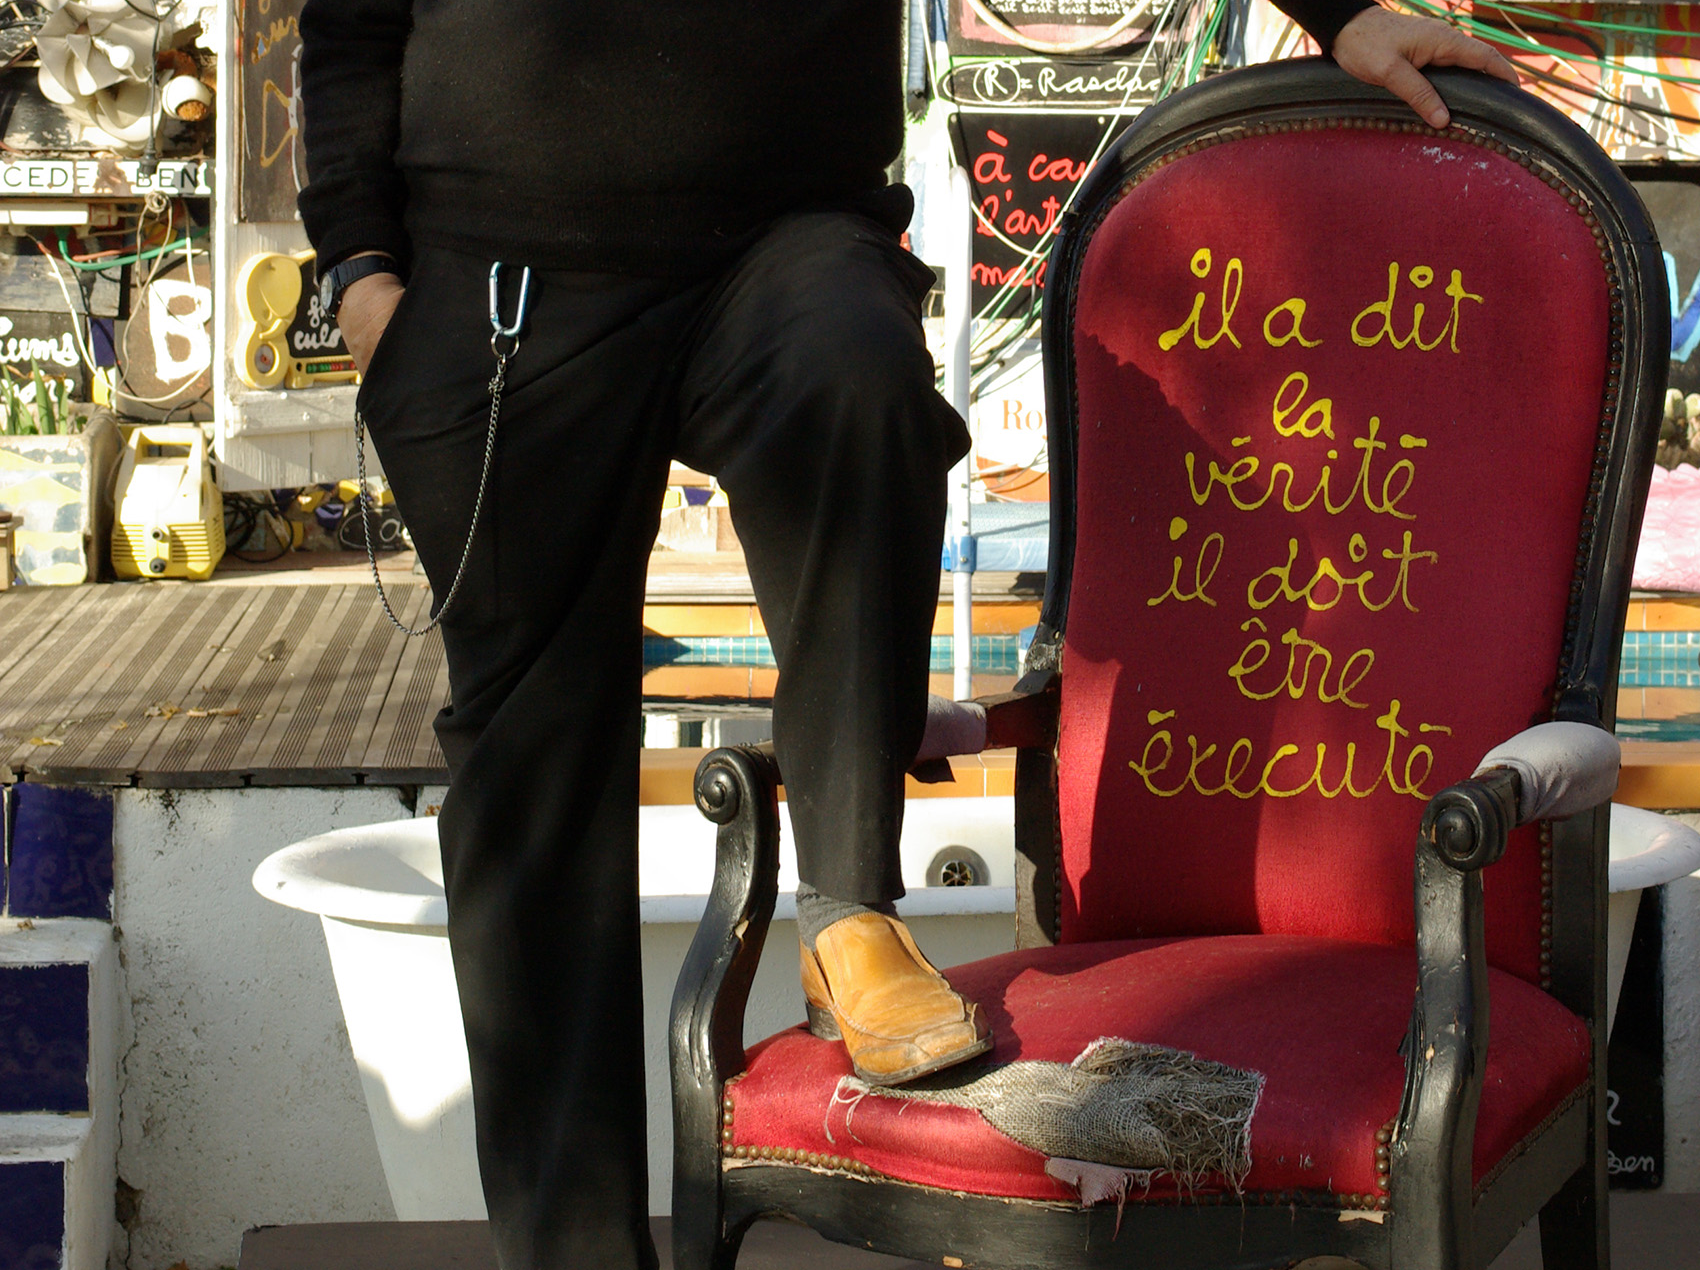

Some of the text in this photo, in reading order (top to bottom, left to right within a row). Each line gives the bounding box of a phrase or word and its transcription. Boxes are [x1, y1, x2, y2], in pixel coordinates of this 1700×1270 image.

[974, 129, 1012, 183] à
[976, 189, 1062, 237] l'art
[1159, 247, 1484, 353] il a dit
[1273, 371, 1335, 440] la
[1185, 416, 1428, 520] vérité
[1147, 516, 1438, 612] il doit
[1228, 617, 1375, 709] être
